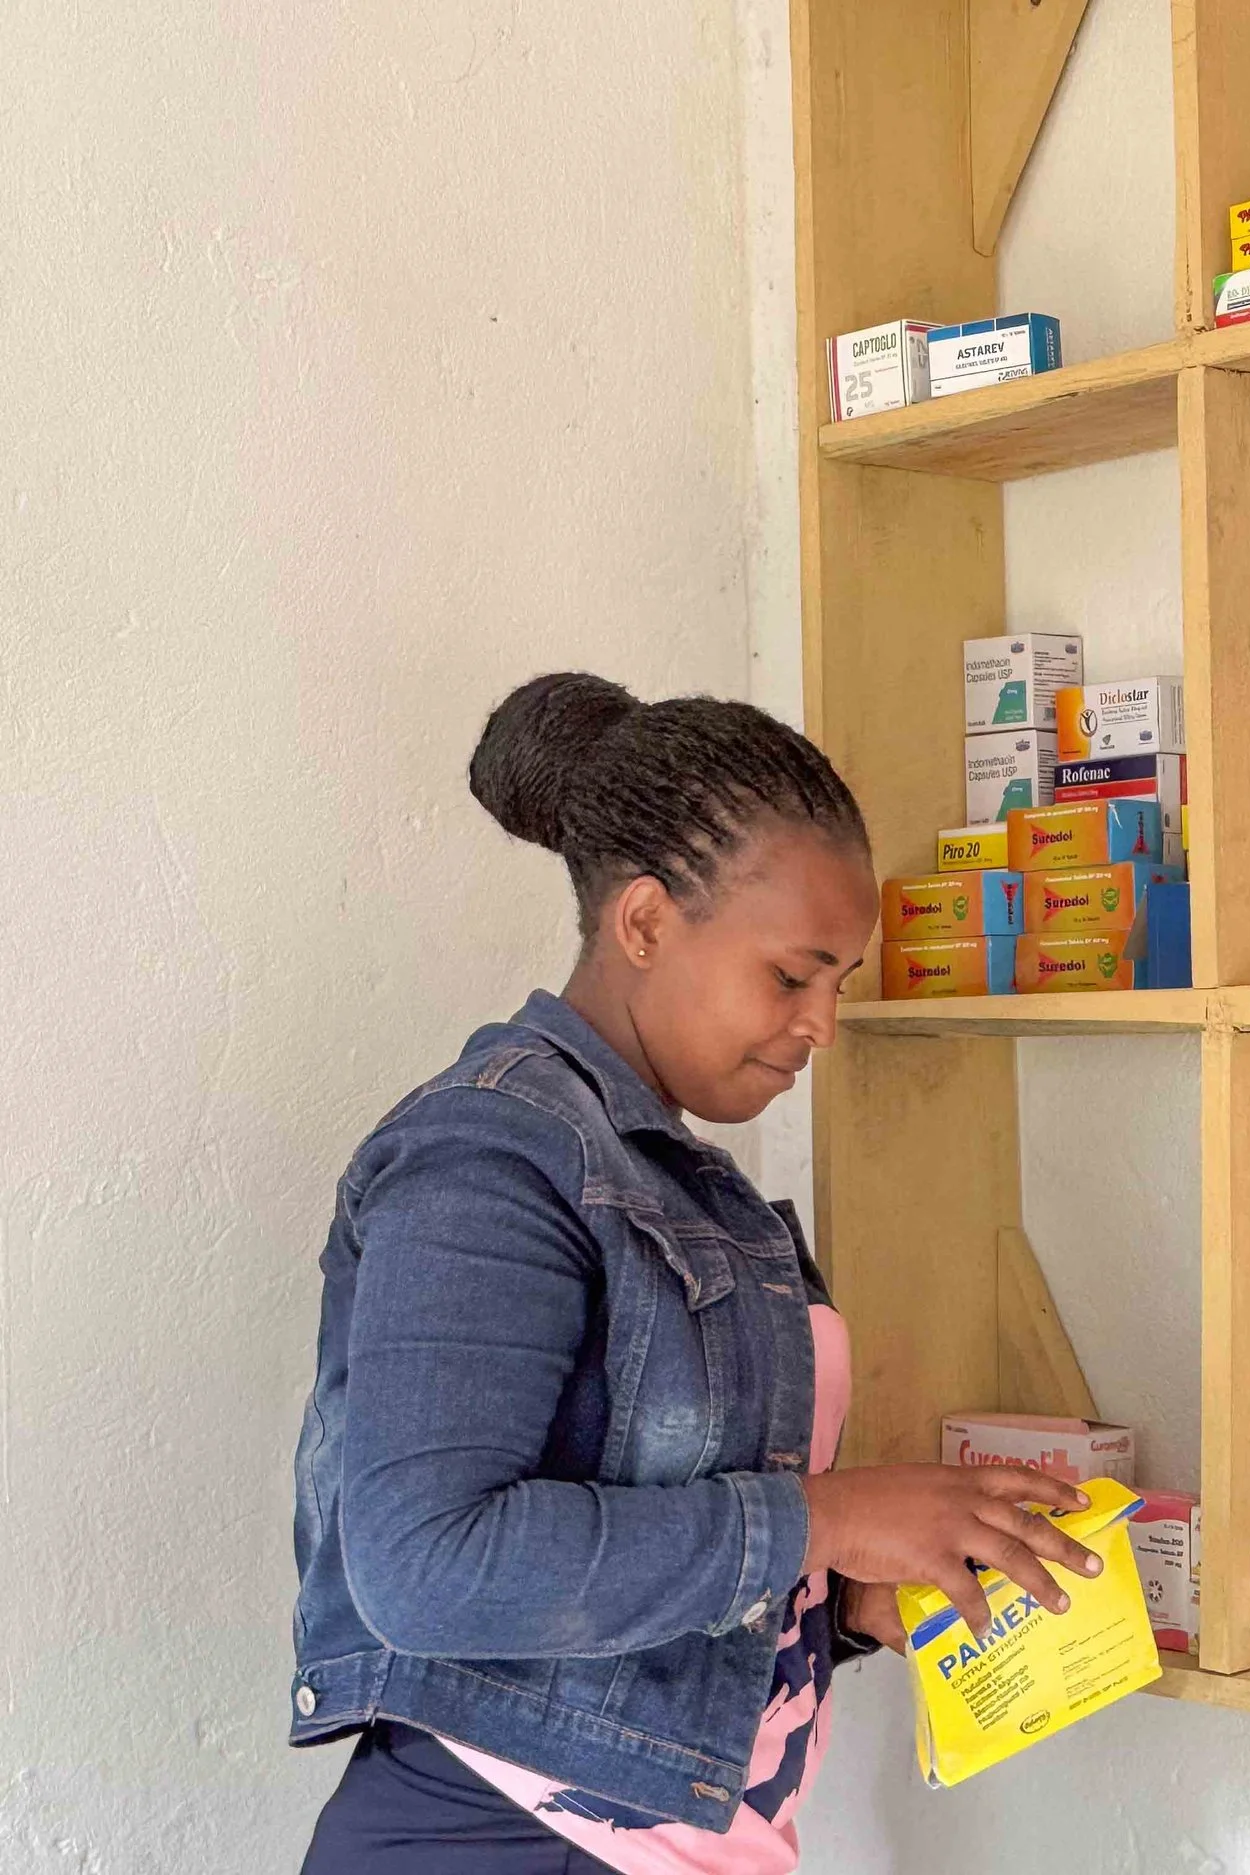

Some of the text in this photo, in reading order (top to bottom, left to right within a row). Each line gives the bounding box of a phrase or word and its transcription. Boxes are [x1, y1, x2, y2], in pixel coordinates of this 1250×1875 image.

[852, 332, 897, 358] CAPTOGLO
[957, 342, 1005, 360] ASTAREV
[845, 371, 873, 401] 25
[1100, 689, 1149, 705] Diclostar
[1062, 766, 1110, 784] Rofenac
[1032, 830, 1072, 845] Suredol
[943, 842, 980, 860] Piro 20
[952, 1660, 987, 1689] EXTRA
[988, 1615, 1043, 1663] STRENGTH
